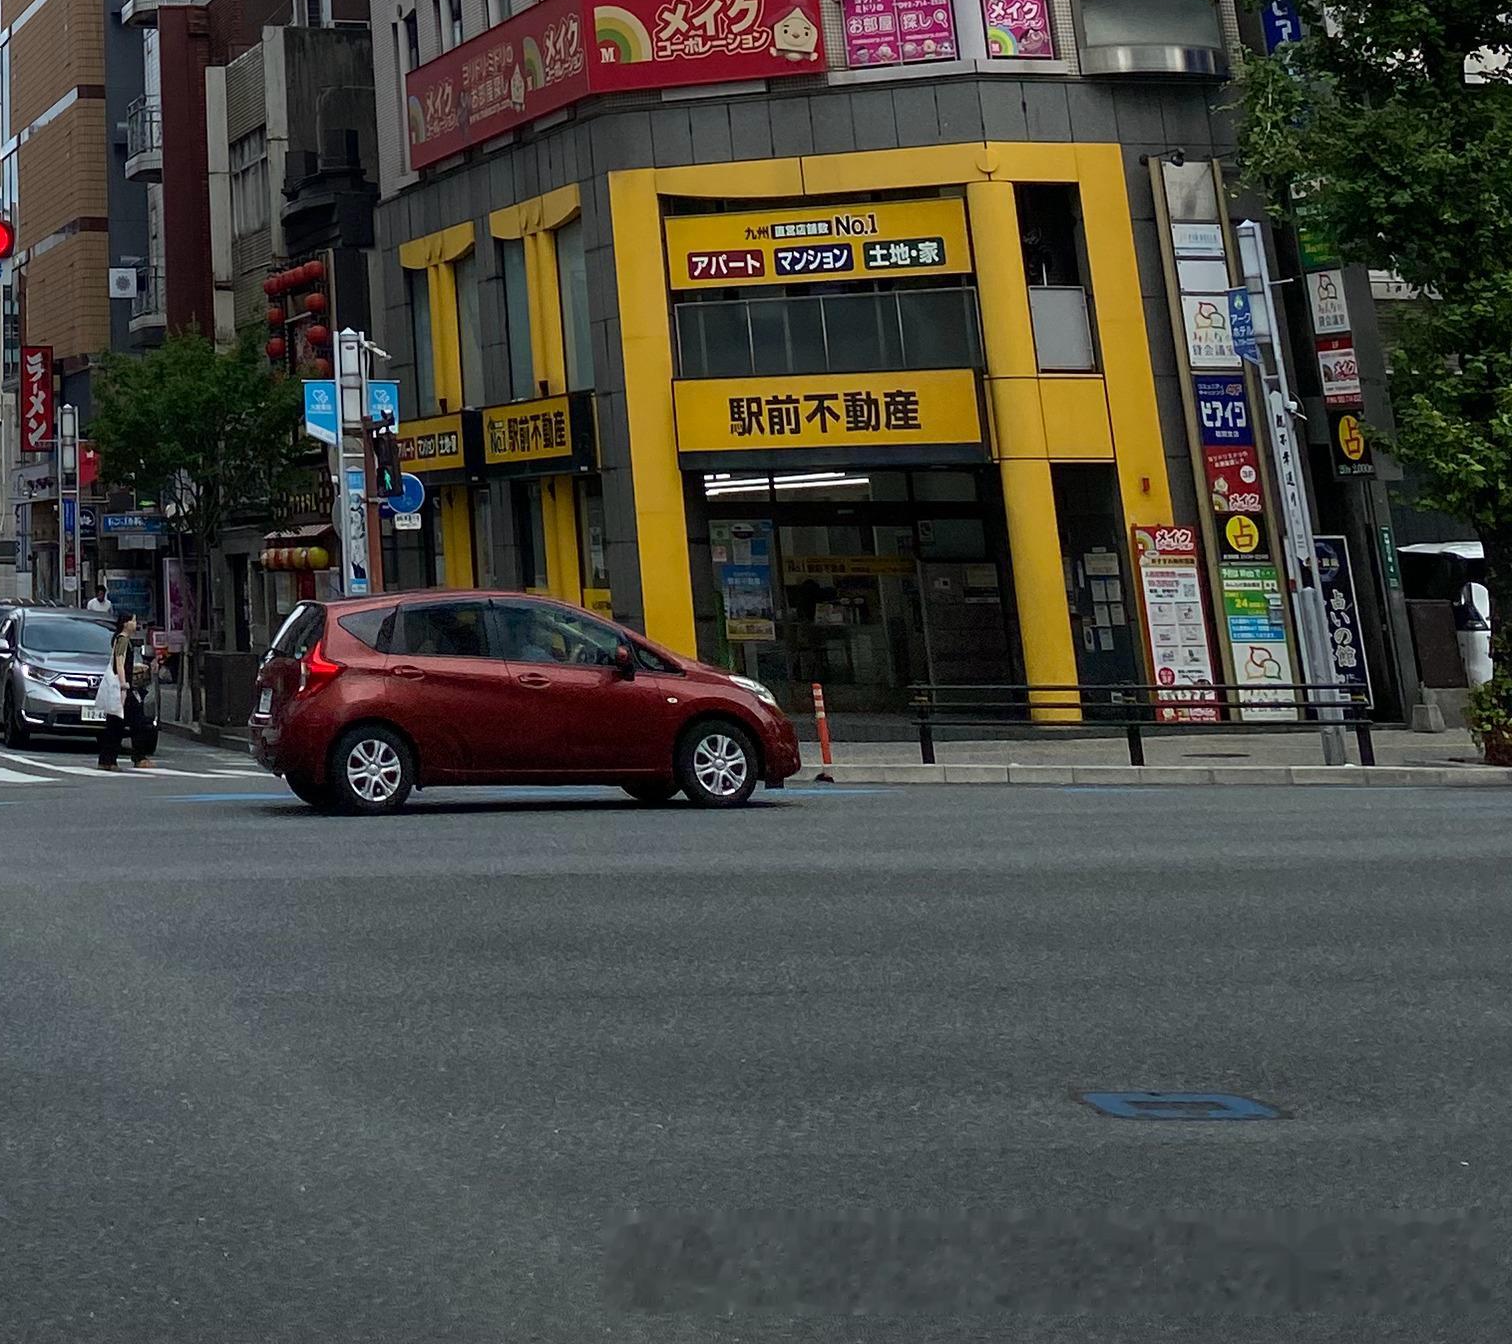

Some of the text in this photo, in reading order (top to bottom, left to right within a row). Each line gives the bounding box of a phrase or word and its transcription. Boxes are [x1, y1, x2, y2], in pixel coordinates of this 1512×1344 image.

[658, 32, 769, 56] コーポレーション
[744, 226, 770, 241] 九州
[834, 214, 878, 236] No.1
[691, 241, 940, 276] アパート マンション 土地・家
[26, 352, 47, 447] ラーメン
[728, 389, 922, 436] 駅前不動産
[1157, 531, 1190, 544] メイク
[1232, 518, 1252, 548] 占
[1330, 589, 1357, 668] 占いの館
